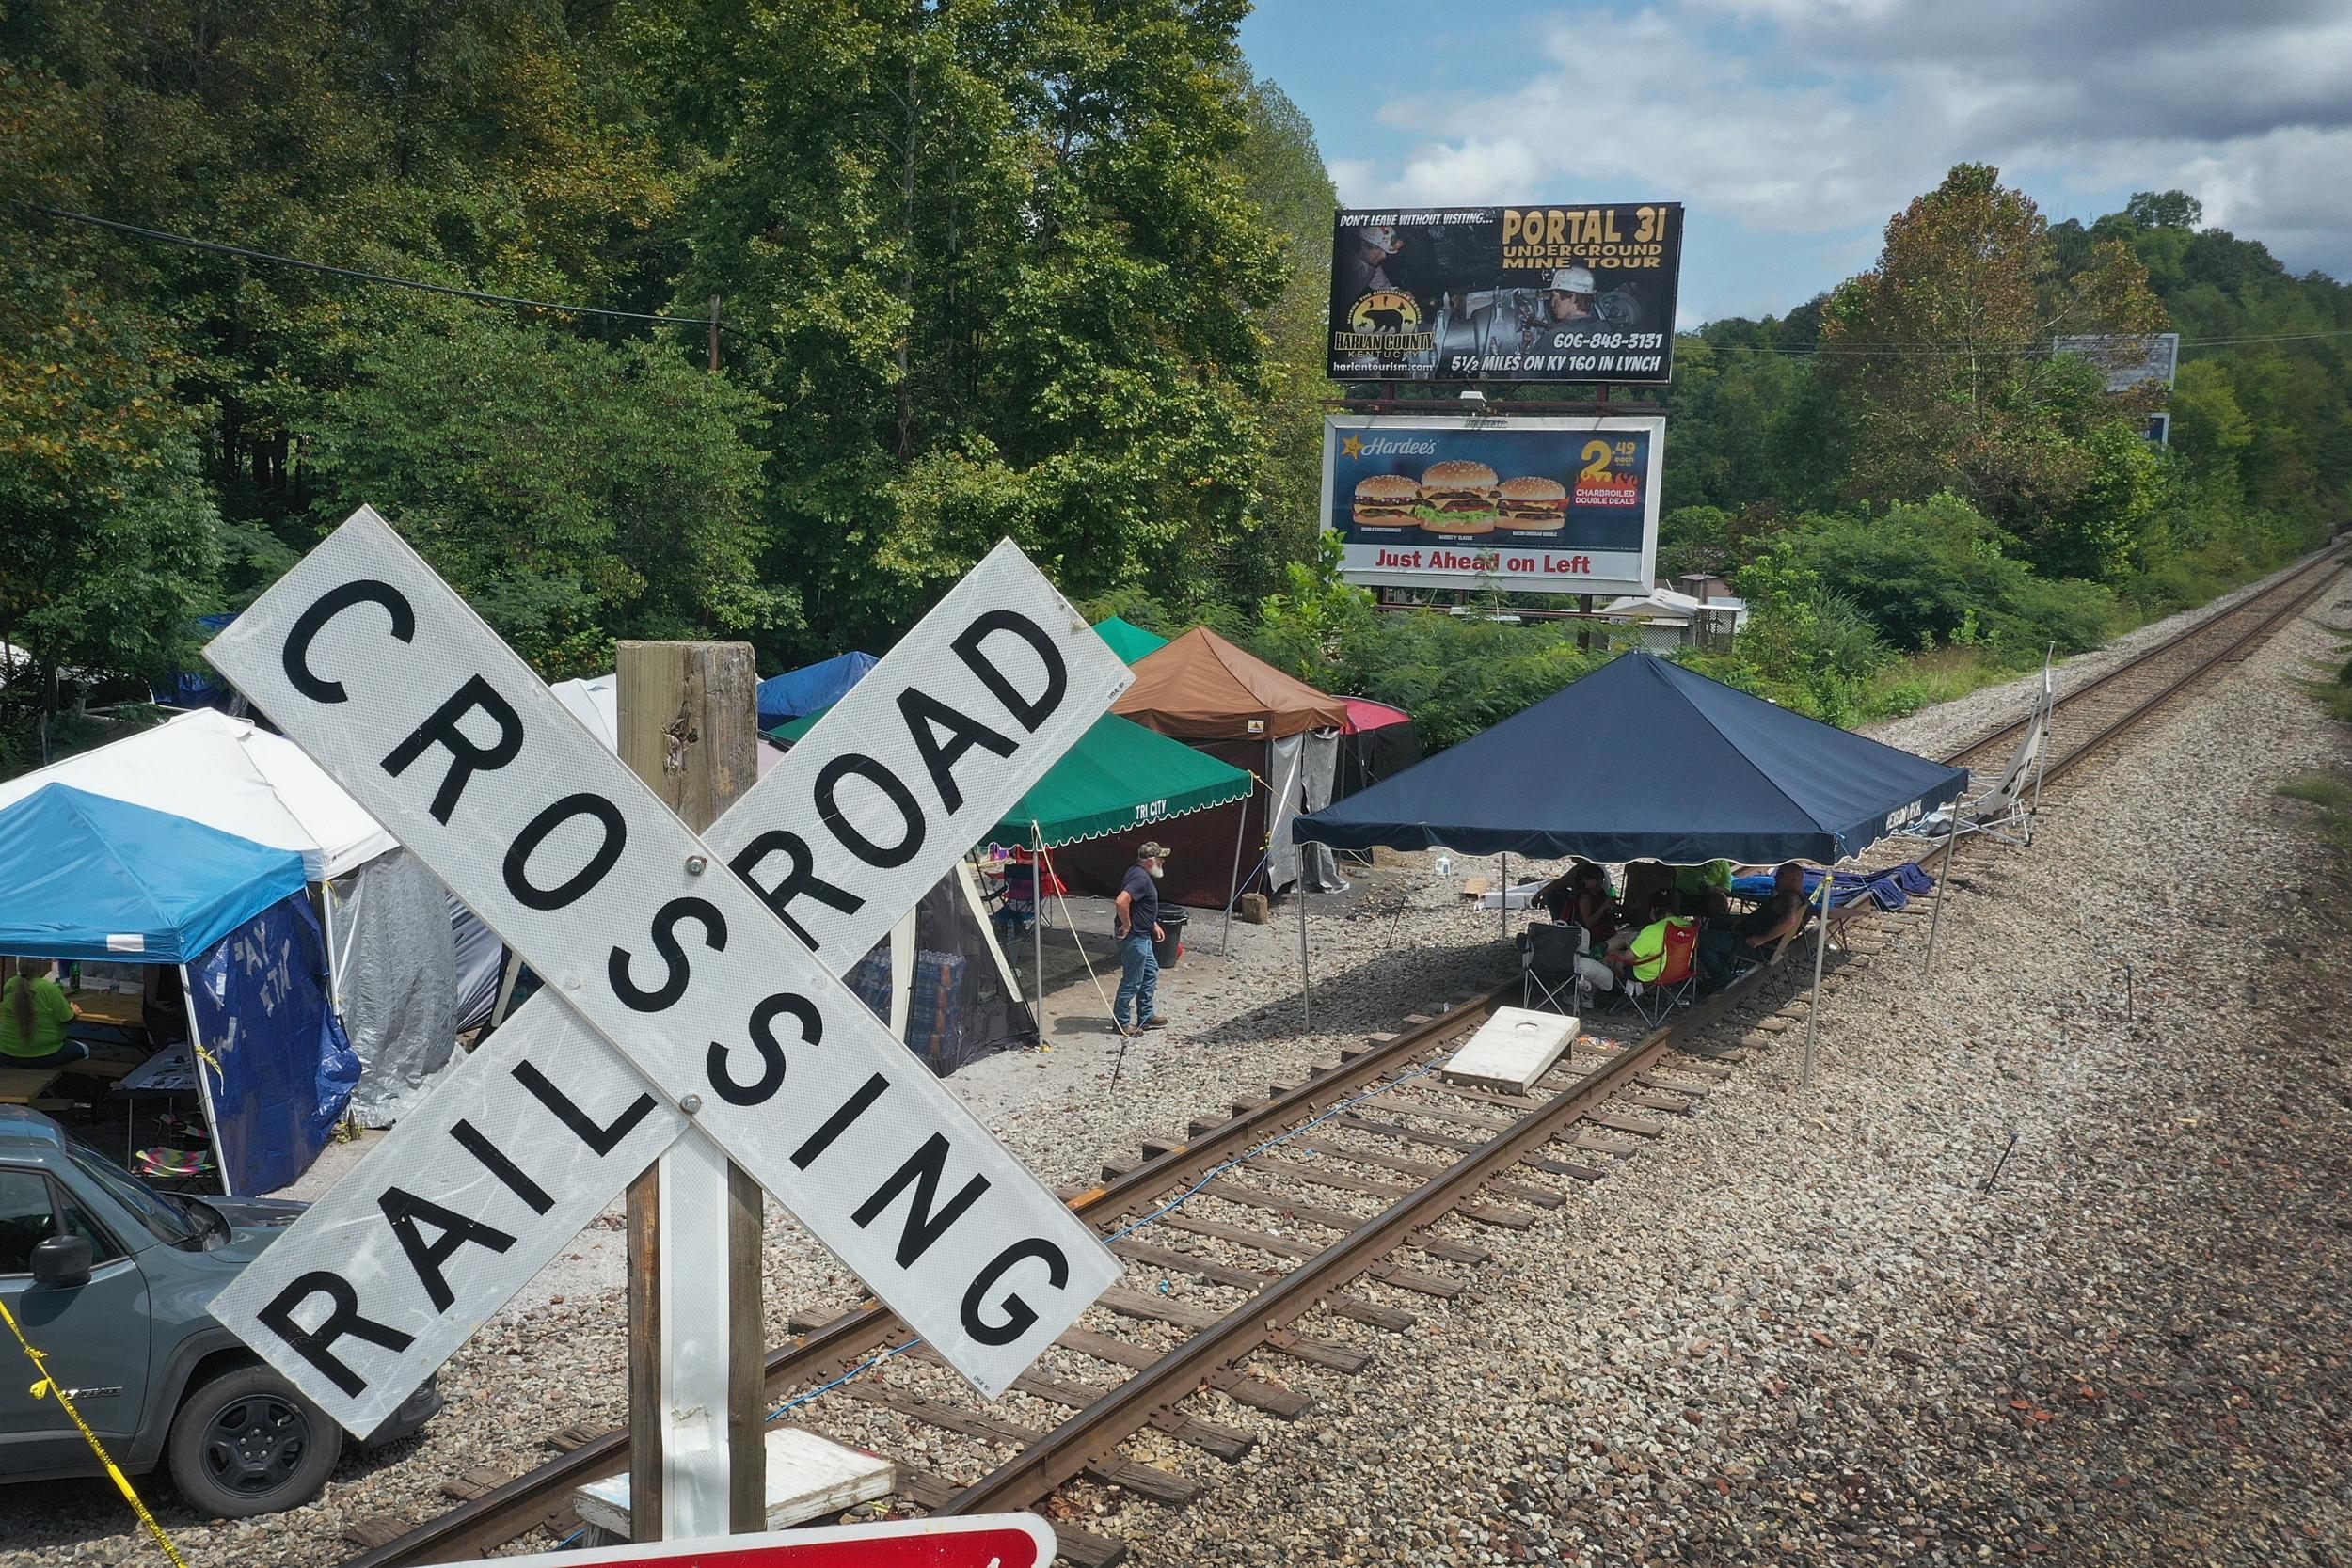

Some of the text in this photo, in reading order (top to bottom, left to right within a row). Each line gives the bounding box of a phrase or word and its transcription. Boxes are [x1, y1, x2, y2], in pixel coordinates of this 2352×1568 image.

[1340, 212, 1494, 227] DON'T LEAVE WITHOUT VISITING...
[1502, 206, 1666, 245] PORTAL 31
[1503, 244, 1662, 257] UNDERGROUND
[1502, 257, 1660, 269] MINE TOUR
[1359, 293, 1372, 302] THE
[1374, 289, 1411, 300] ADVENTURE
[1334, 331, 1435, 350] HARLAN COUNTY
[1553, 333, 1663, 350] 606-848-3131
[1348, 350, 1420, 358] KENTUCKY
[1333, 361, 1433, 371] harlantourism.com
[1481, 356, 1520, 372] MILES
[1523, 356, 1546, 371] ON
[1547, 356, 1566, 371] KY
[1569, 356, 1596, 372] 160
[1598, 356, 1614, 372] IN
[1616, 356, 1661, 372] LYNCH
[1360, 437, 1438, 455] Hardee's
[1575, 497, 1608, 505] DOUBLE
[1576, 489, 1635, 498] CHARBROILED
[1375, 549, 1590, 574] Just Ahead on Left
[1136, 800, 1167, 819] TRI CITY
[281, 579, 1069, 1347] CROSSING
